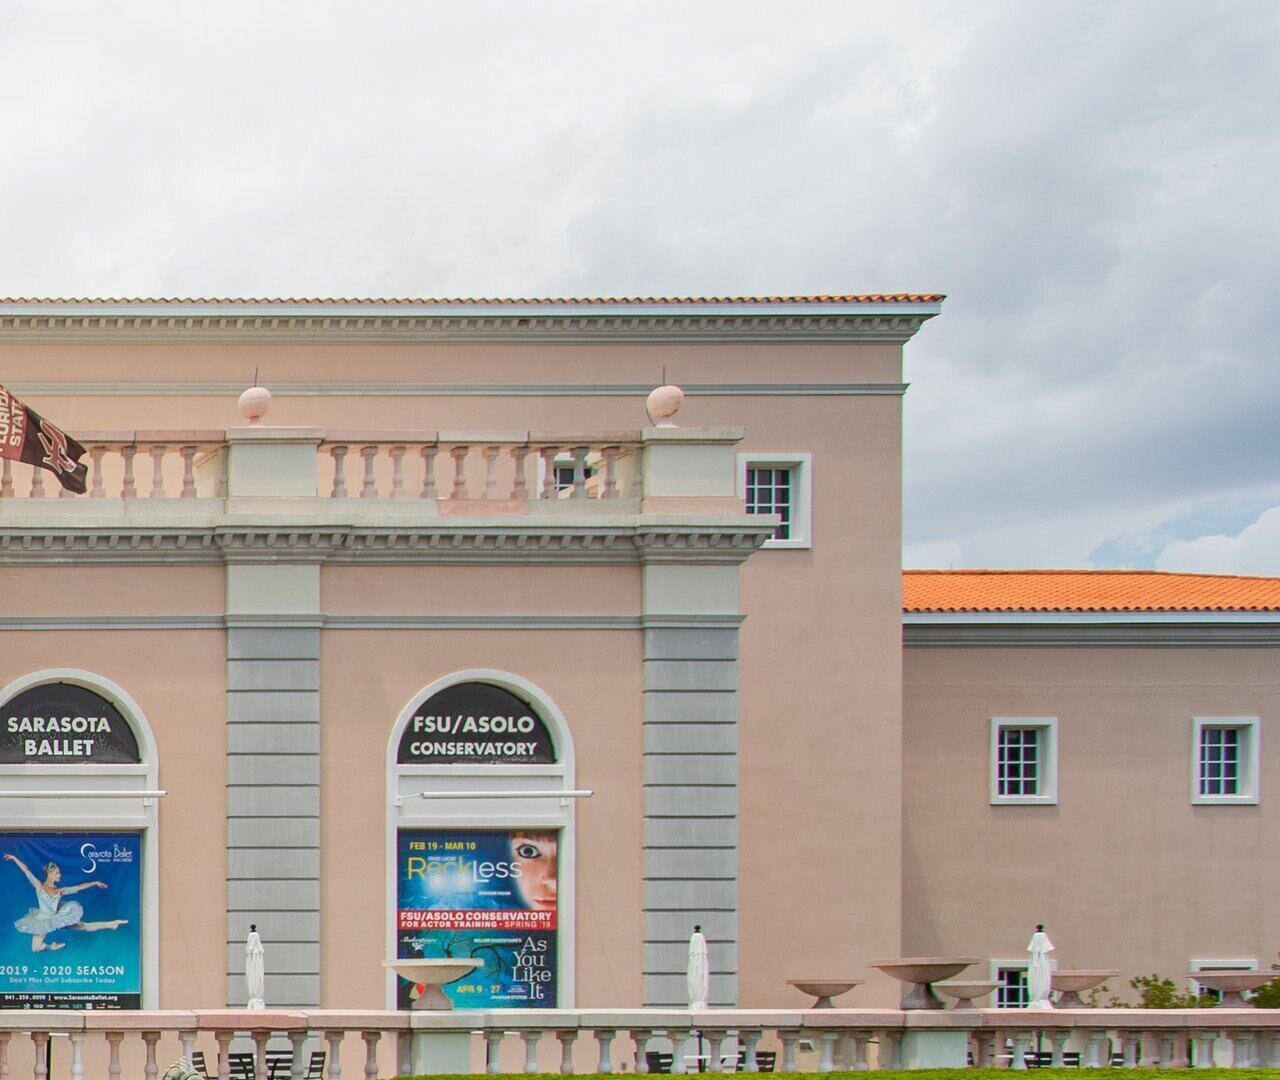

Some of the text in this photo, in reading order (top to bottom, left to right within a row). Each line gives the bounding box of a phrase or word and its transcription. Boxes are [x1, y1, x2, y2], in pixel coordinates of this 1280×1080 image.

[7, 716, 112, 733] SARASOTA
[413, 716, 535, 734] FSU/ASOLO
[24, 739, 95, 756] BALLET
[410, 742, 538, 756] CONSERVATORY
[113, 843, 133, 858] Ballet
[409, 842, 426, 851] FEB
[428, 842, 438, 851] 19
[444, 842, 464, 851] MAR
[466, 842, 477, 851] 10
[400, 912, 552, 921] FSU/ASOLO CONSERVATORY
[523, 936, 547, 952] As
[513, 951, 545, 967] You
[0, 966, 29, 975] 2019
[42, 966, 73, 975] 2020
[76, 966, 125, 975] SEASON
[511, 966, 552, 983] Like
[456, 985, 474, 994] APR
[476, 985, 483, 994] 9
[490, 985, 501, 994] 27
[528, 982, 545, 1000] It
